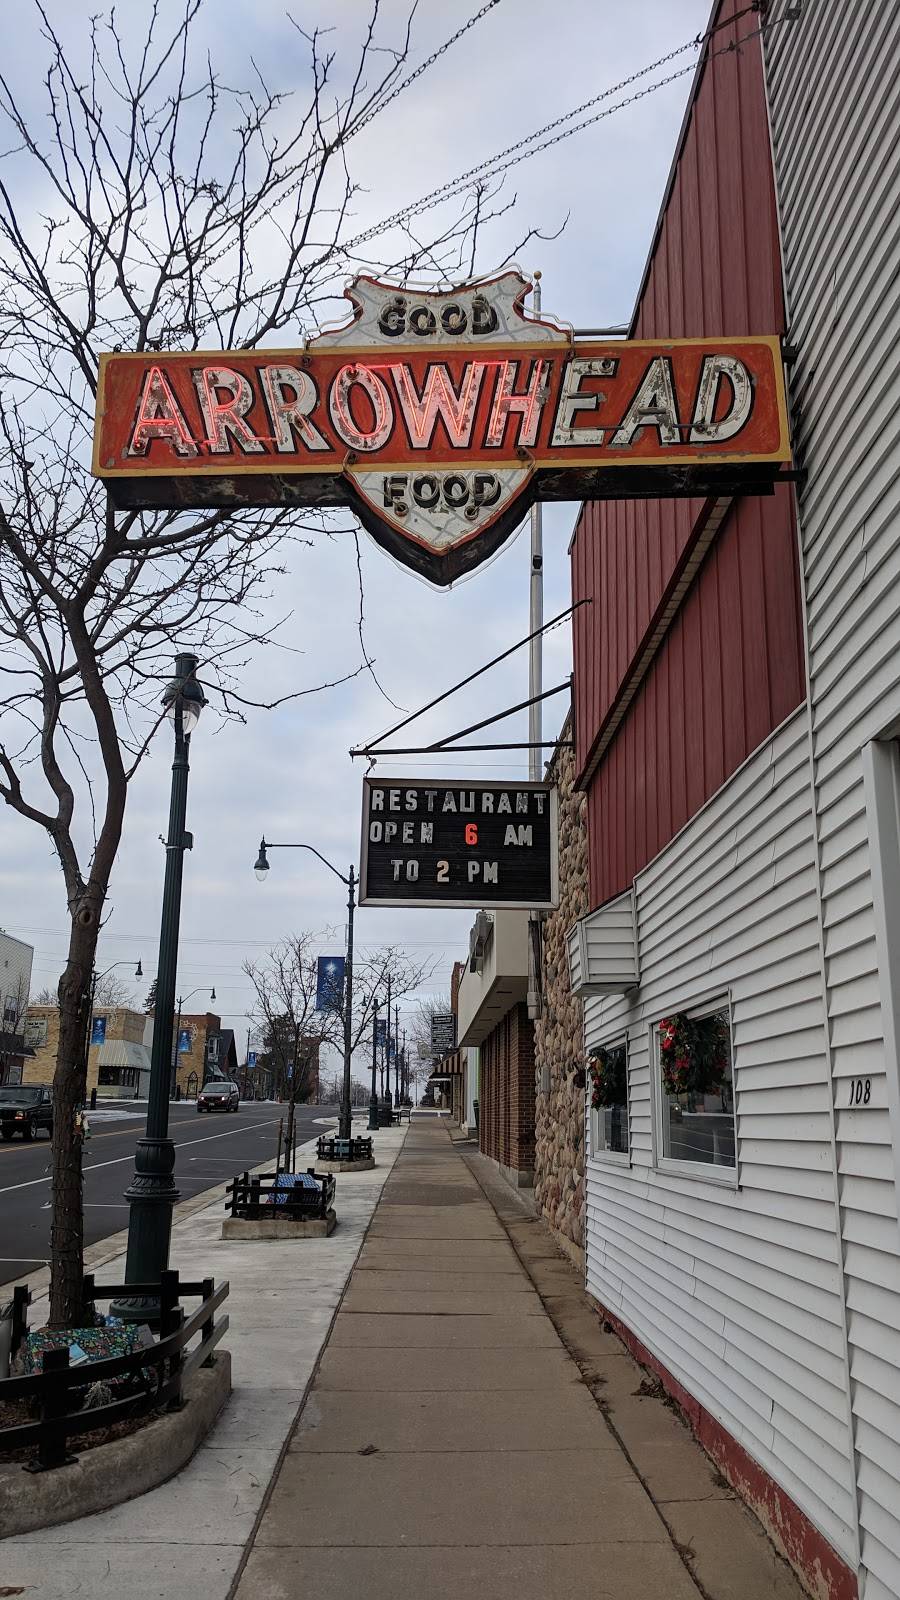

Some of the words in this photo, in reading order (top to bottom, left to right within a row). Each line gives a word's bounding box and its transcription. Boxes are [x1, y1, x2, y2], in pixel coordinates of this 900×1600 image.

[378, 294, 499, 337] GOOD
[126, 352, 756, 456] ARROWHEAD
[383, 473, 502, 508] FOOD
[371, 789, 547, 815] RESTAURANT
[369, 821, 434, 844] OPEN
[465, 823, 478, 845] 6
[504, 824, 533, 847] AM
[391, 859, 419, 882] TO
[436, 860, 450, 883] 2
[467, 860, 499, 884] PM
[849, 1079, 871, 1105] 108
